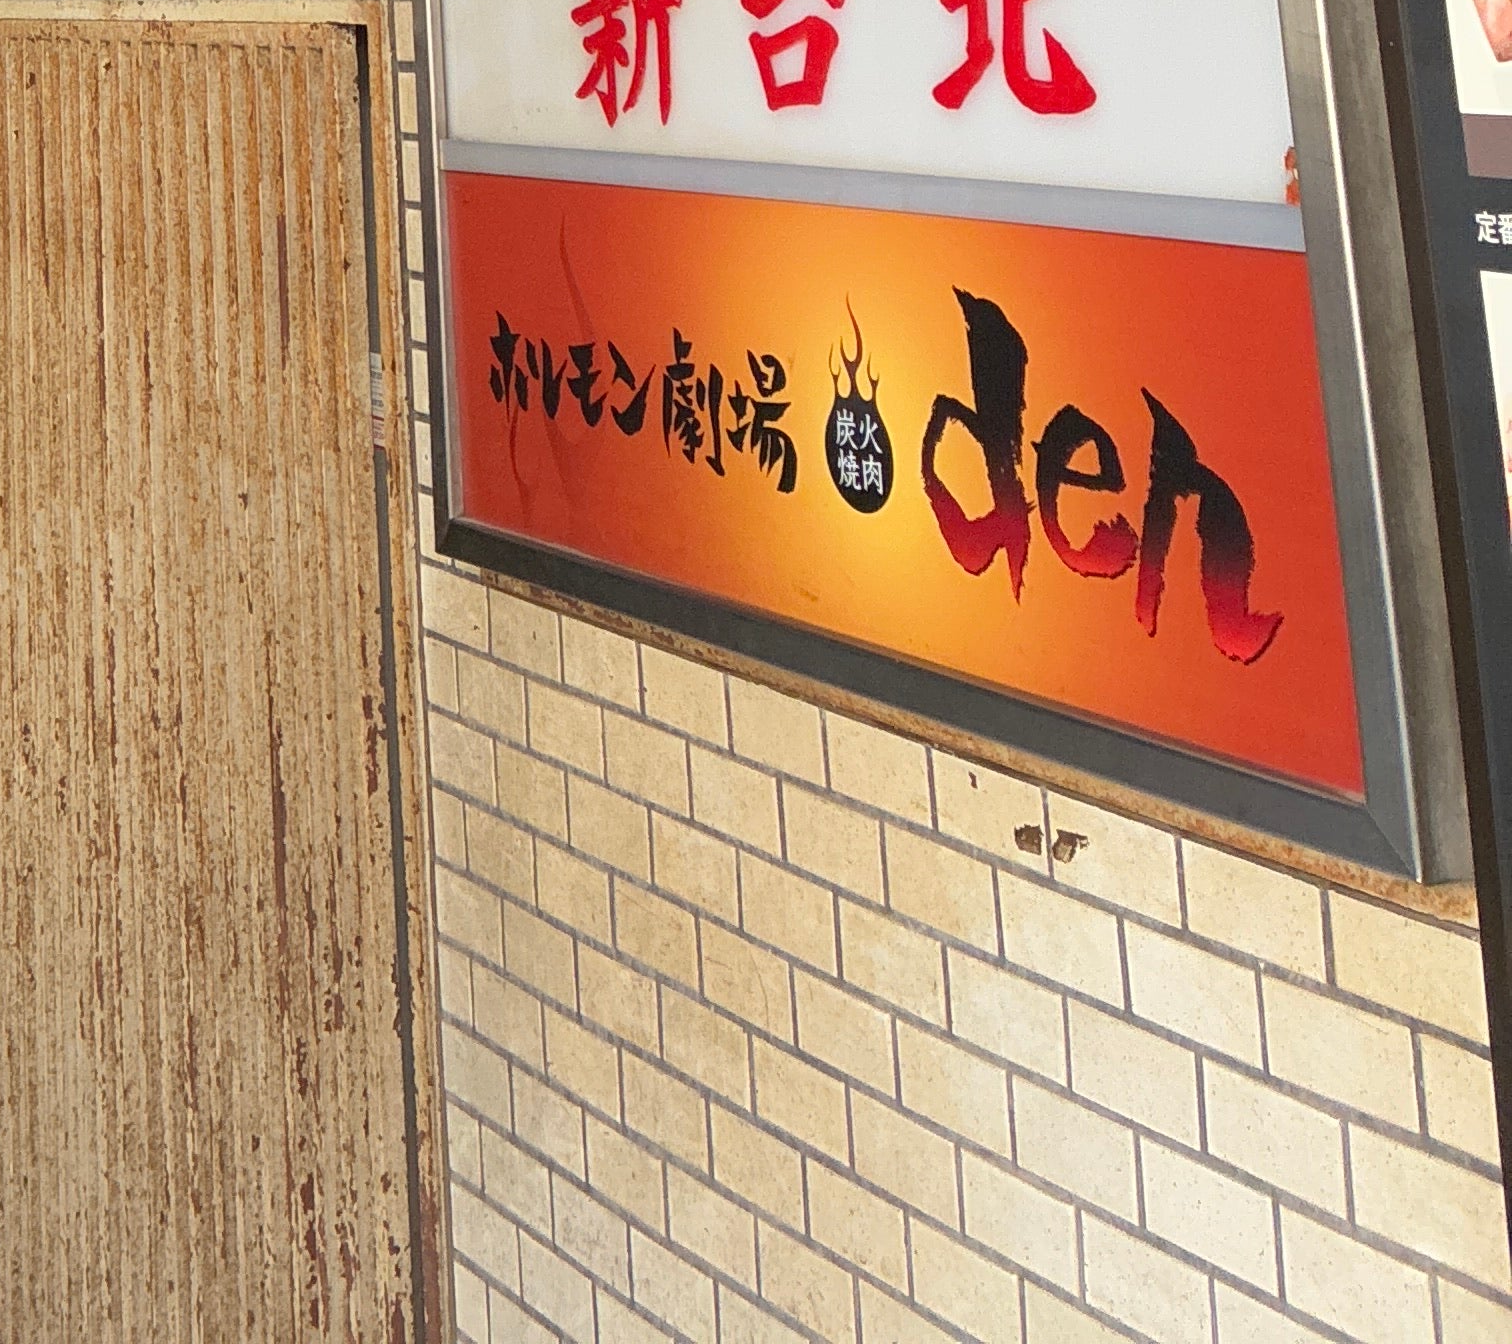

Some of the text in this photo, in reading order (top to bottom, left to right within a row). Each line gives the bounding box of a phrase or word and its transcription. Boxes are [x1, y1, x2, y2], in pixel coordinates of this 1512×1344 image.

[489, 311, 798, 494] ホルモン劇場
[922, 285, 1284, 666] den
